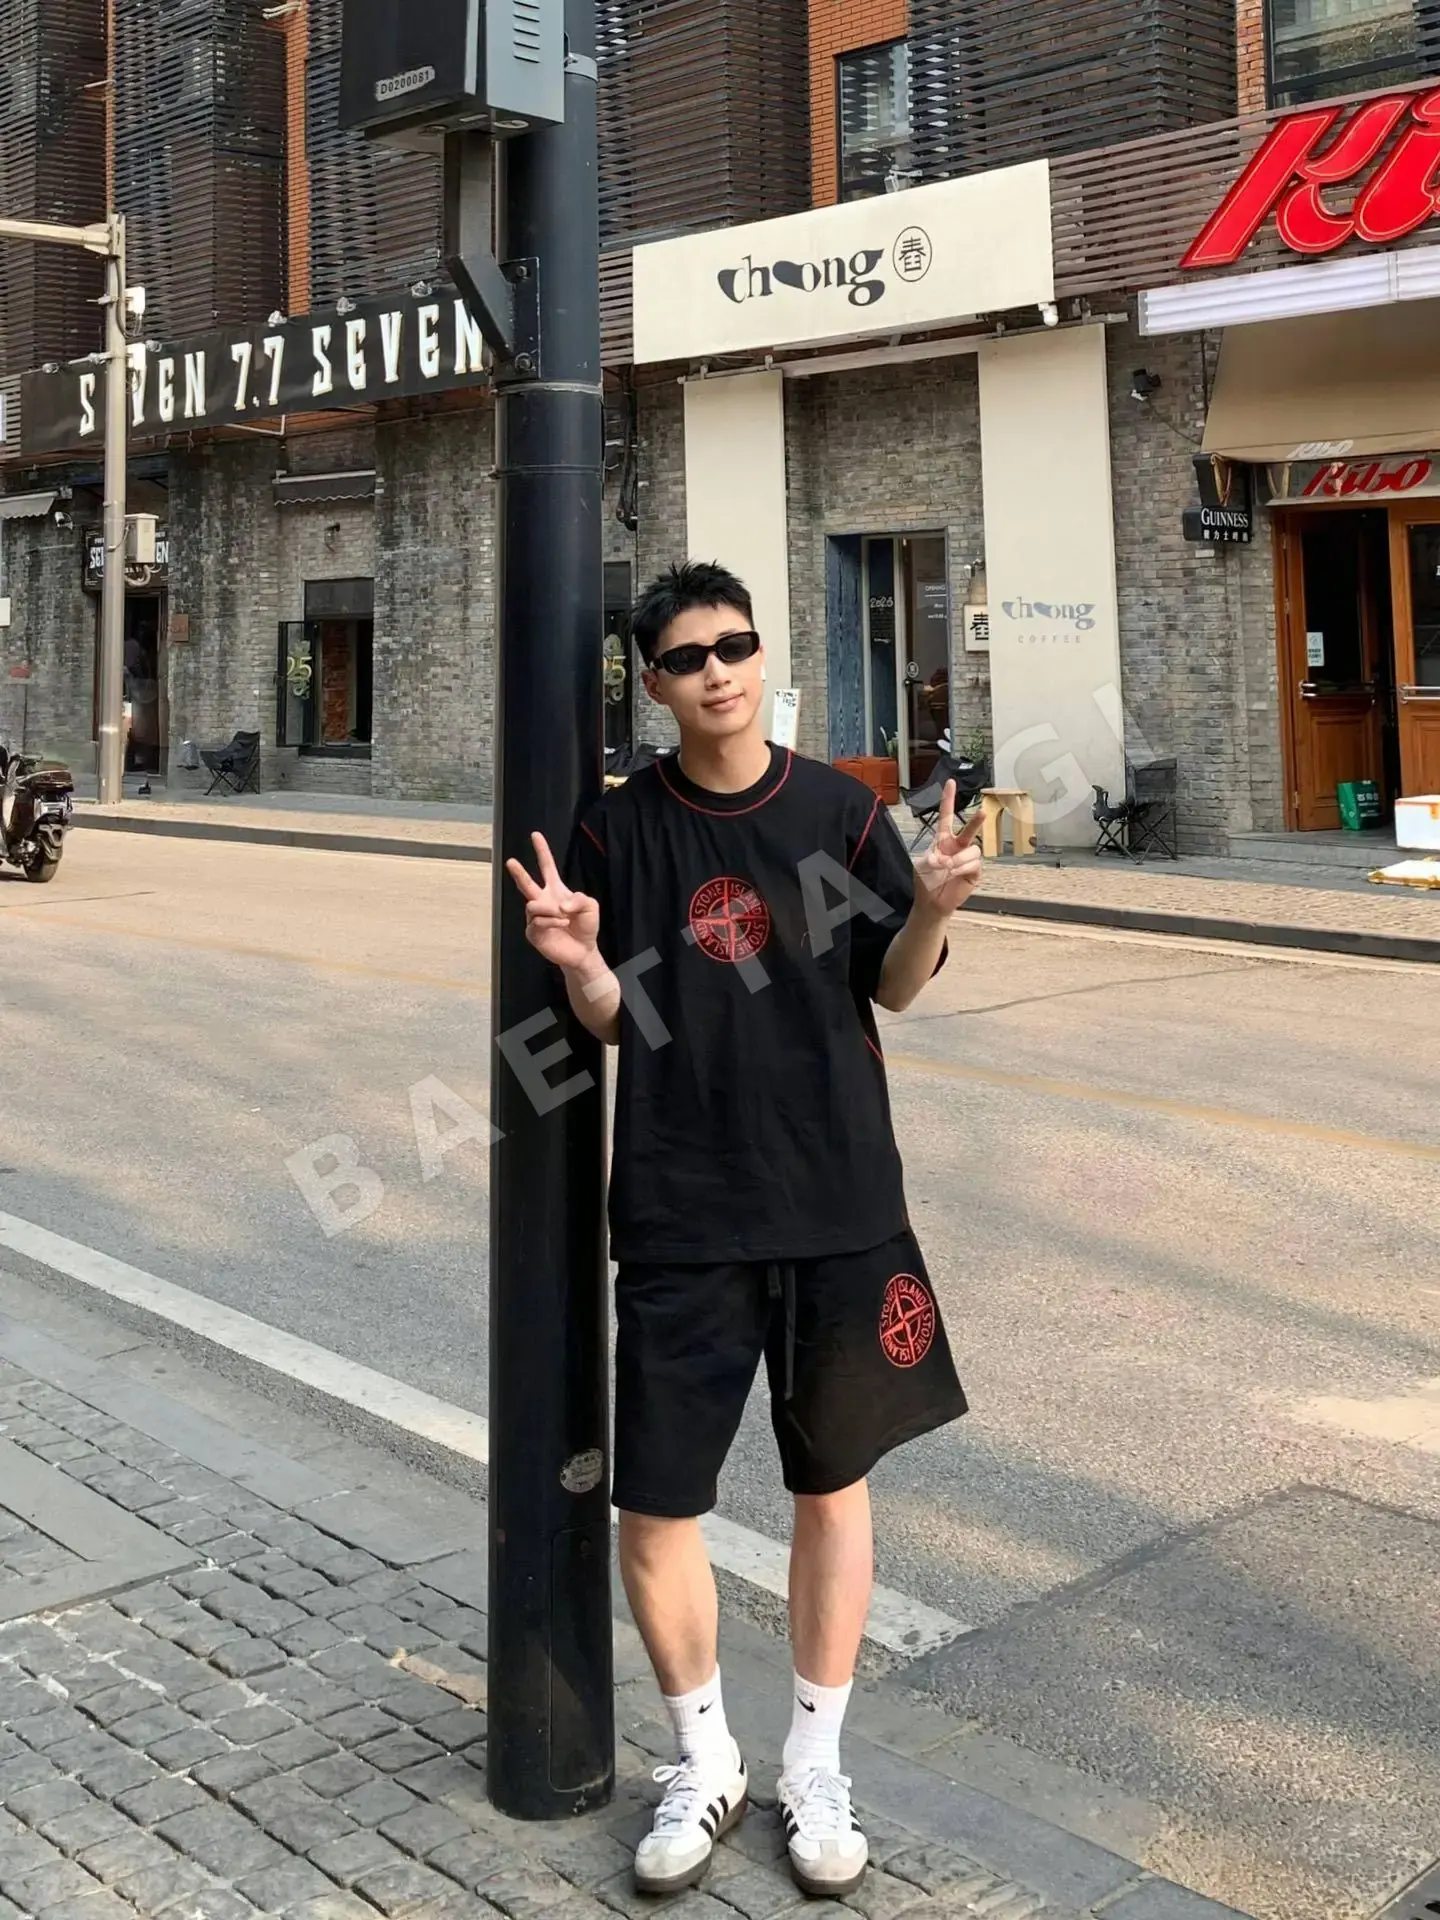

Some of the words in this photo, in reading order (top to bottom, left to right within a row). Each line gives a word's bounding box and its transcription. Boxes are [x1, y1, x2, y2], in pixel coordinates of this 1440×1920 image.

[1180, 84, 1440, 269] Ki
[79, 343, 206, 437] SVEN
[231, 335, 285, 411] 7.7
[311, 299, 484, 397] SEVEN
[1201, 507, 1249, 529] GUINNESS
[694, 882, 724, 915] STONE
[731, 883, 762, 915] ISLAND
[695, 922, 729, 955] ISLAND
[736, 921, 765, 955] STONE
[881, 1286, 894, 1327] STONE
[899, 1279, 927, 1306] ISLAND
[884, 1334, 912, 1361] ISLAND
[914, 1312, 932, 1355] STONE
